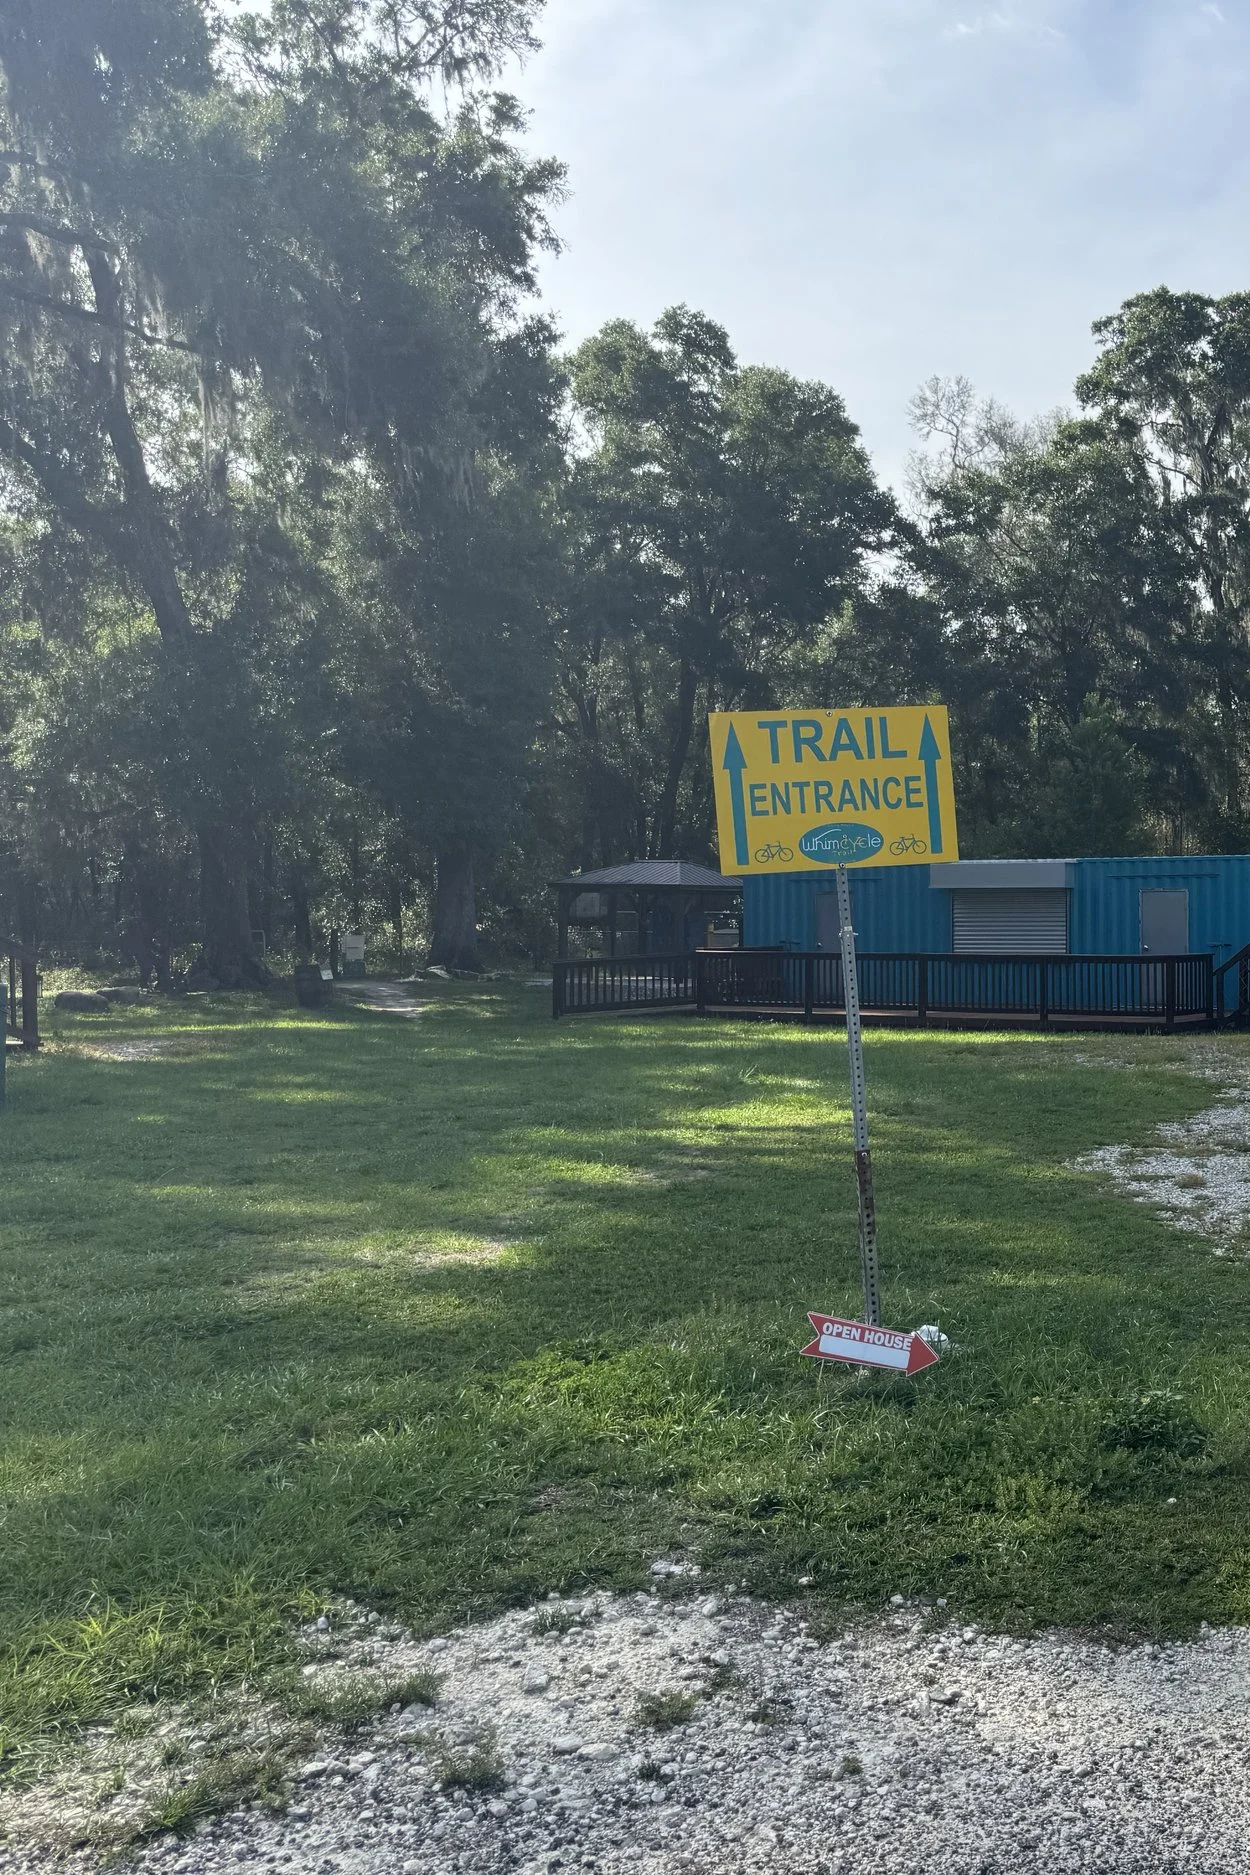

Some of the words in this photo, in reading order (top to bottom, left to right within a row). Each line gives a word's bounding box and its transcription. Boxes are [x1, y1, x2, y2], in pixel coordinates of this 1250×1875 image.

[758, 716, 907, 764] TRAIL
[749, 775, 923, 817] ENTRANCE
[822, 1322, 862, 1341] OPEN
[864, 1331, 913, 1350] HOUSE
